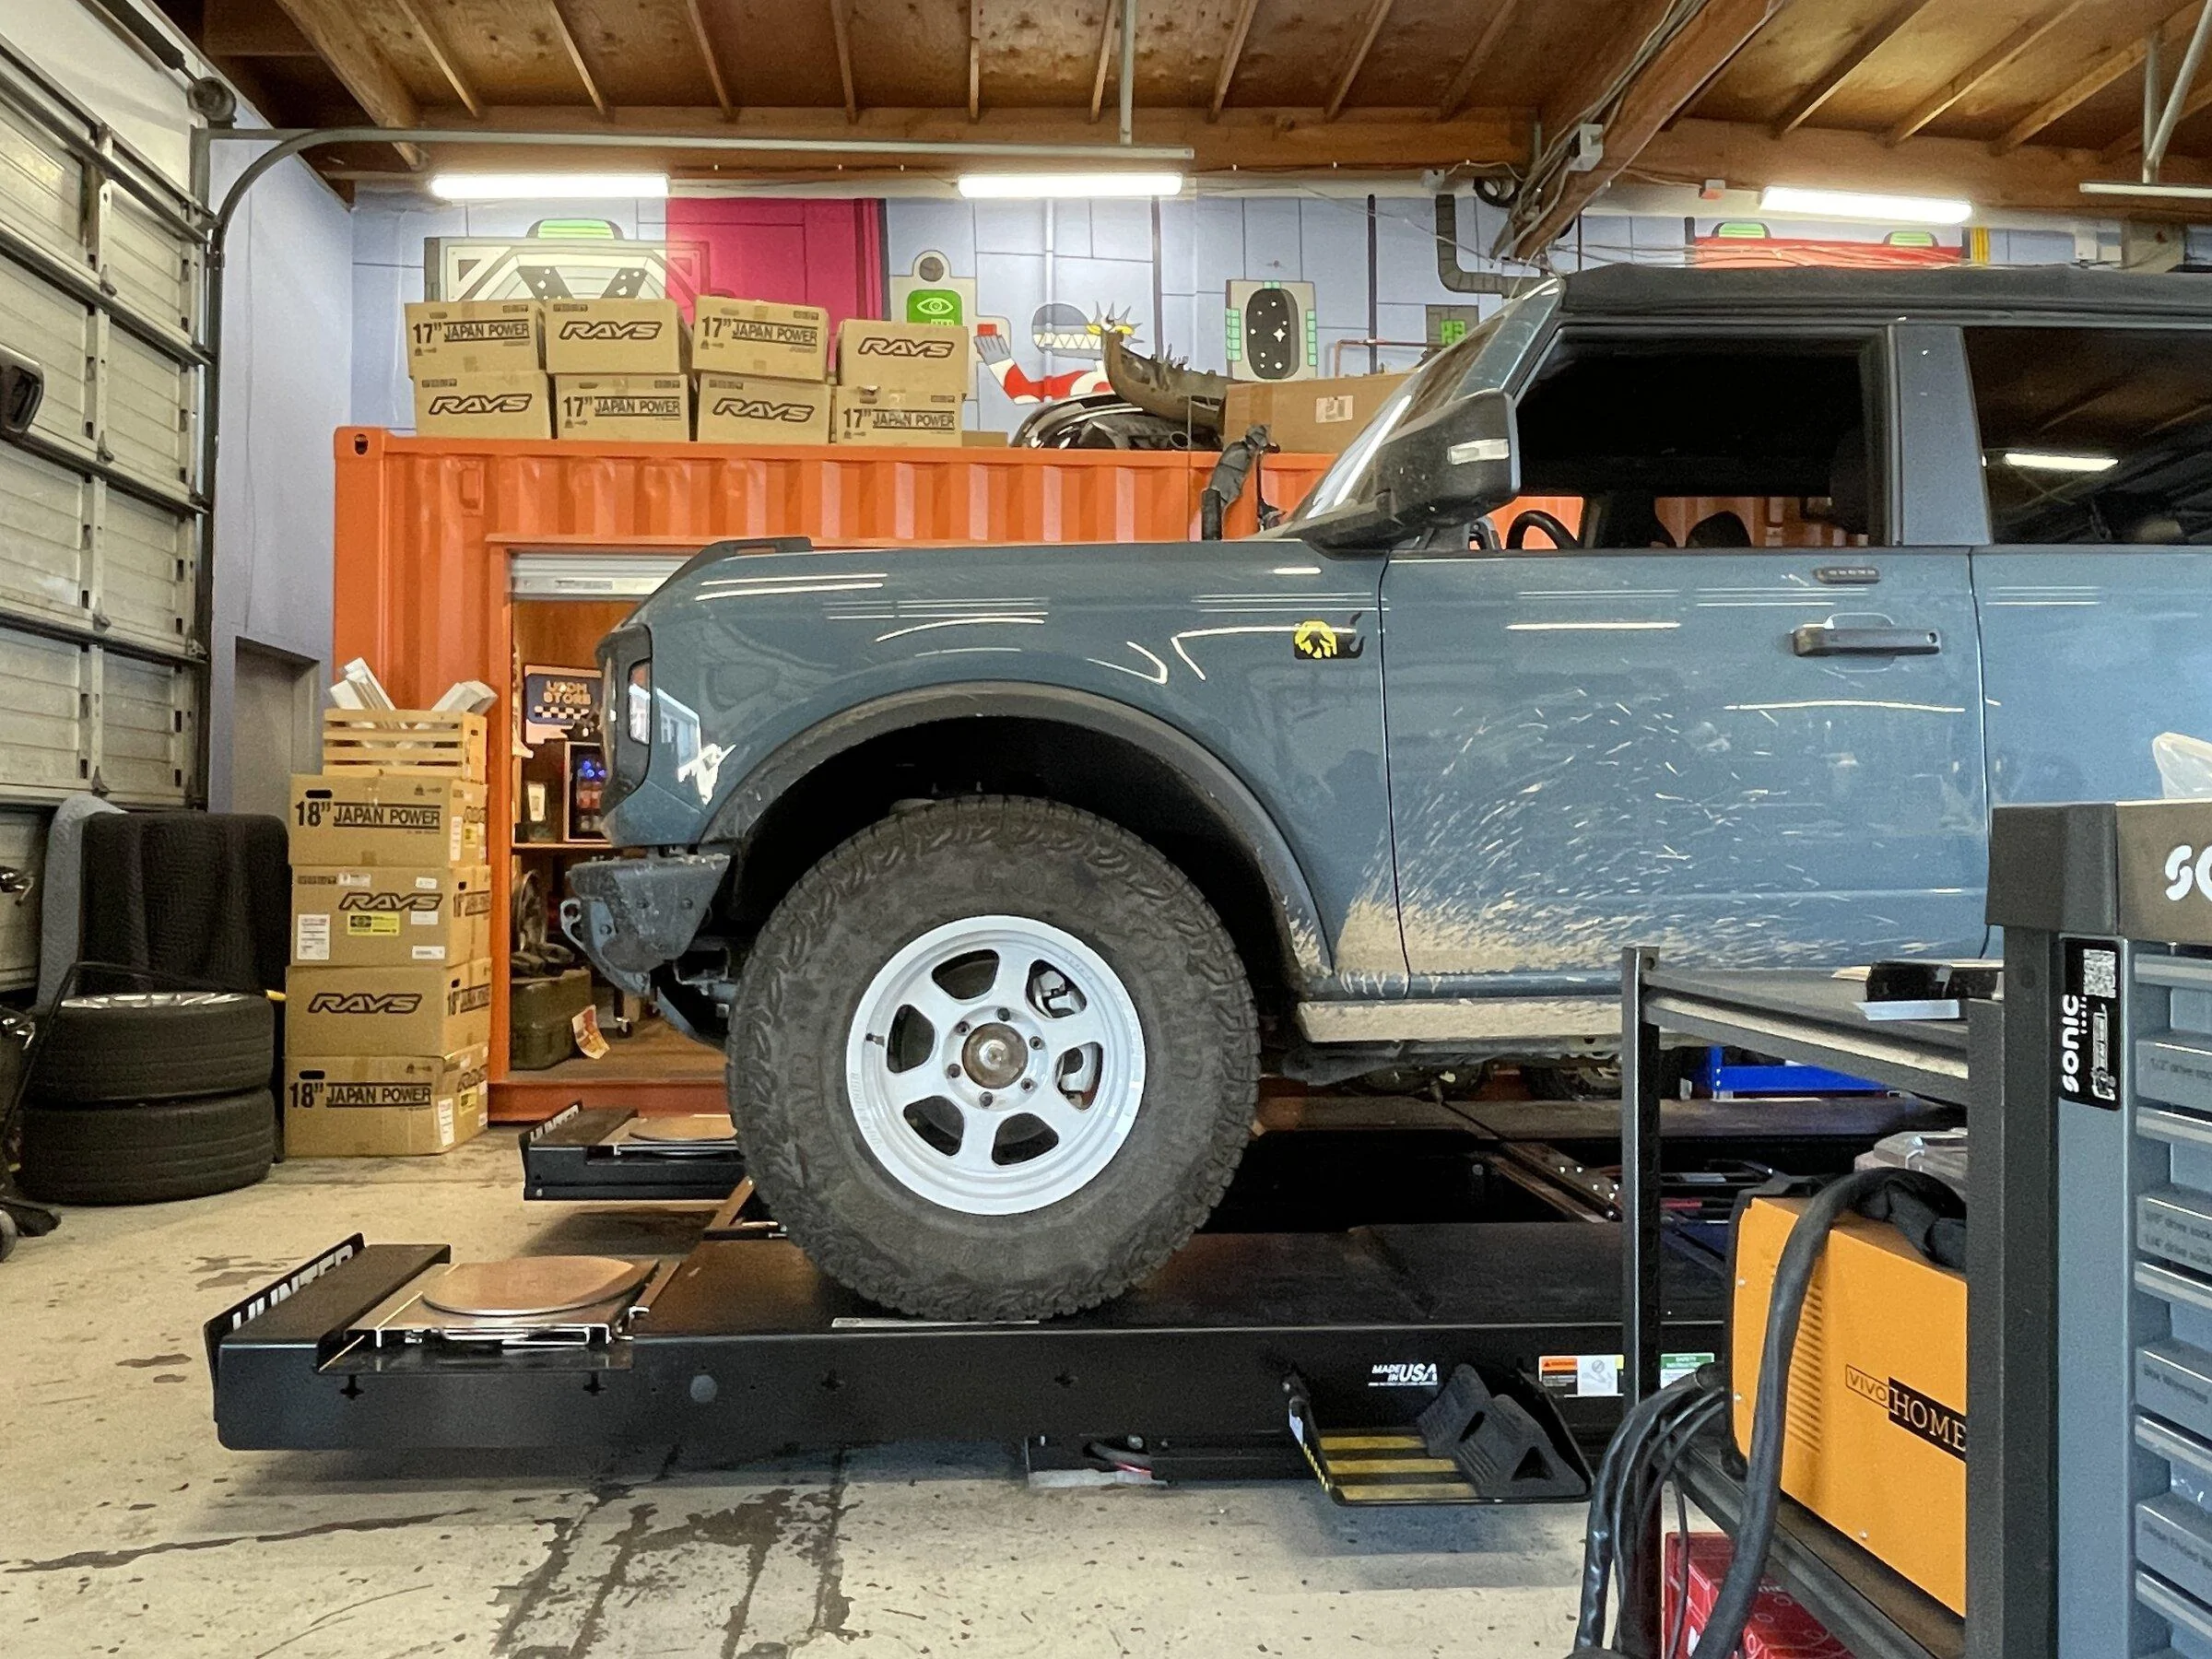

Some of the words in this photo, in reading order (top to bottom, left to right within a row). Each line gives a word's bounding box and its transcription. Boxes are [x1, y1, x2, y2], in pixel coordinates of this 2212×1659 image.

[413, 322, 442, 345] 17"
[443, 323, 484, 341] JAPAN
[488, 323, 530, 338] POWER
[559, 321, 663, 340] RAYS
[701, 316, 732, 339] 17"
[732, 323, 774, 340] JAPAN
[777, 328, 818, 343] POWER
[858, 336, 956, 359] RAYS
[429, 393, 533, 416] RAYS
[563, 395, 593, 418] 17"
[594, 398, 637, 416] JAPAN
[639, 399, 681, 415] POWER
[712, 397, 816, 422] RAYS
[842, 407, 872, 429] 17"
[873, 412, 912, 429] JAPAN
[914, 414, 955, 428] POWER
[295, 800, 332, 828] 18"
[333, 806, 385, 825] JAPAN
[389, 808, 441, 826] POWER
[338, 892, 443, 912] RAYS
[307, 993, 423, 1015] RAYS
[2062, 994, 2080, 1093] sonic
[288, 1082, 325, 1109] 18"
[326, 1087, 377, 1104] JAPAN
[381, 1087, 432, 1104] POWER
[1371, 1364, 1401, 1374] MADE
[1399, 1363, 1438, 1382] USA
[1849, 1371, 1888, 1402] VIVO
[1889, 1386, 1966, 1452] HOME
